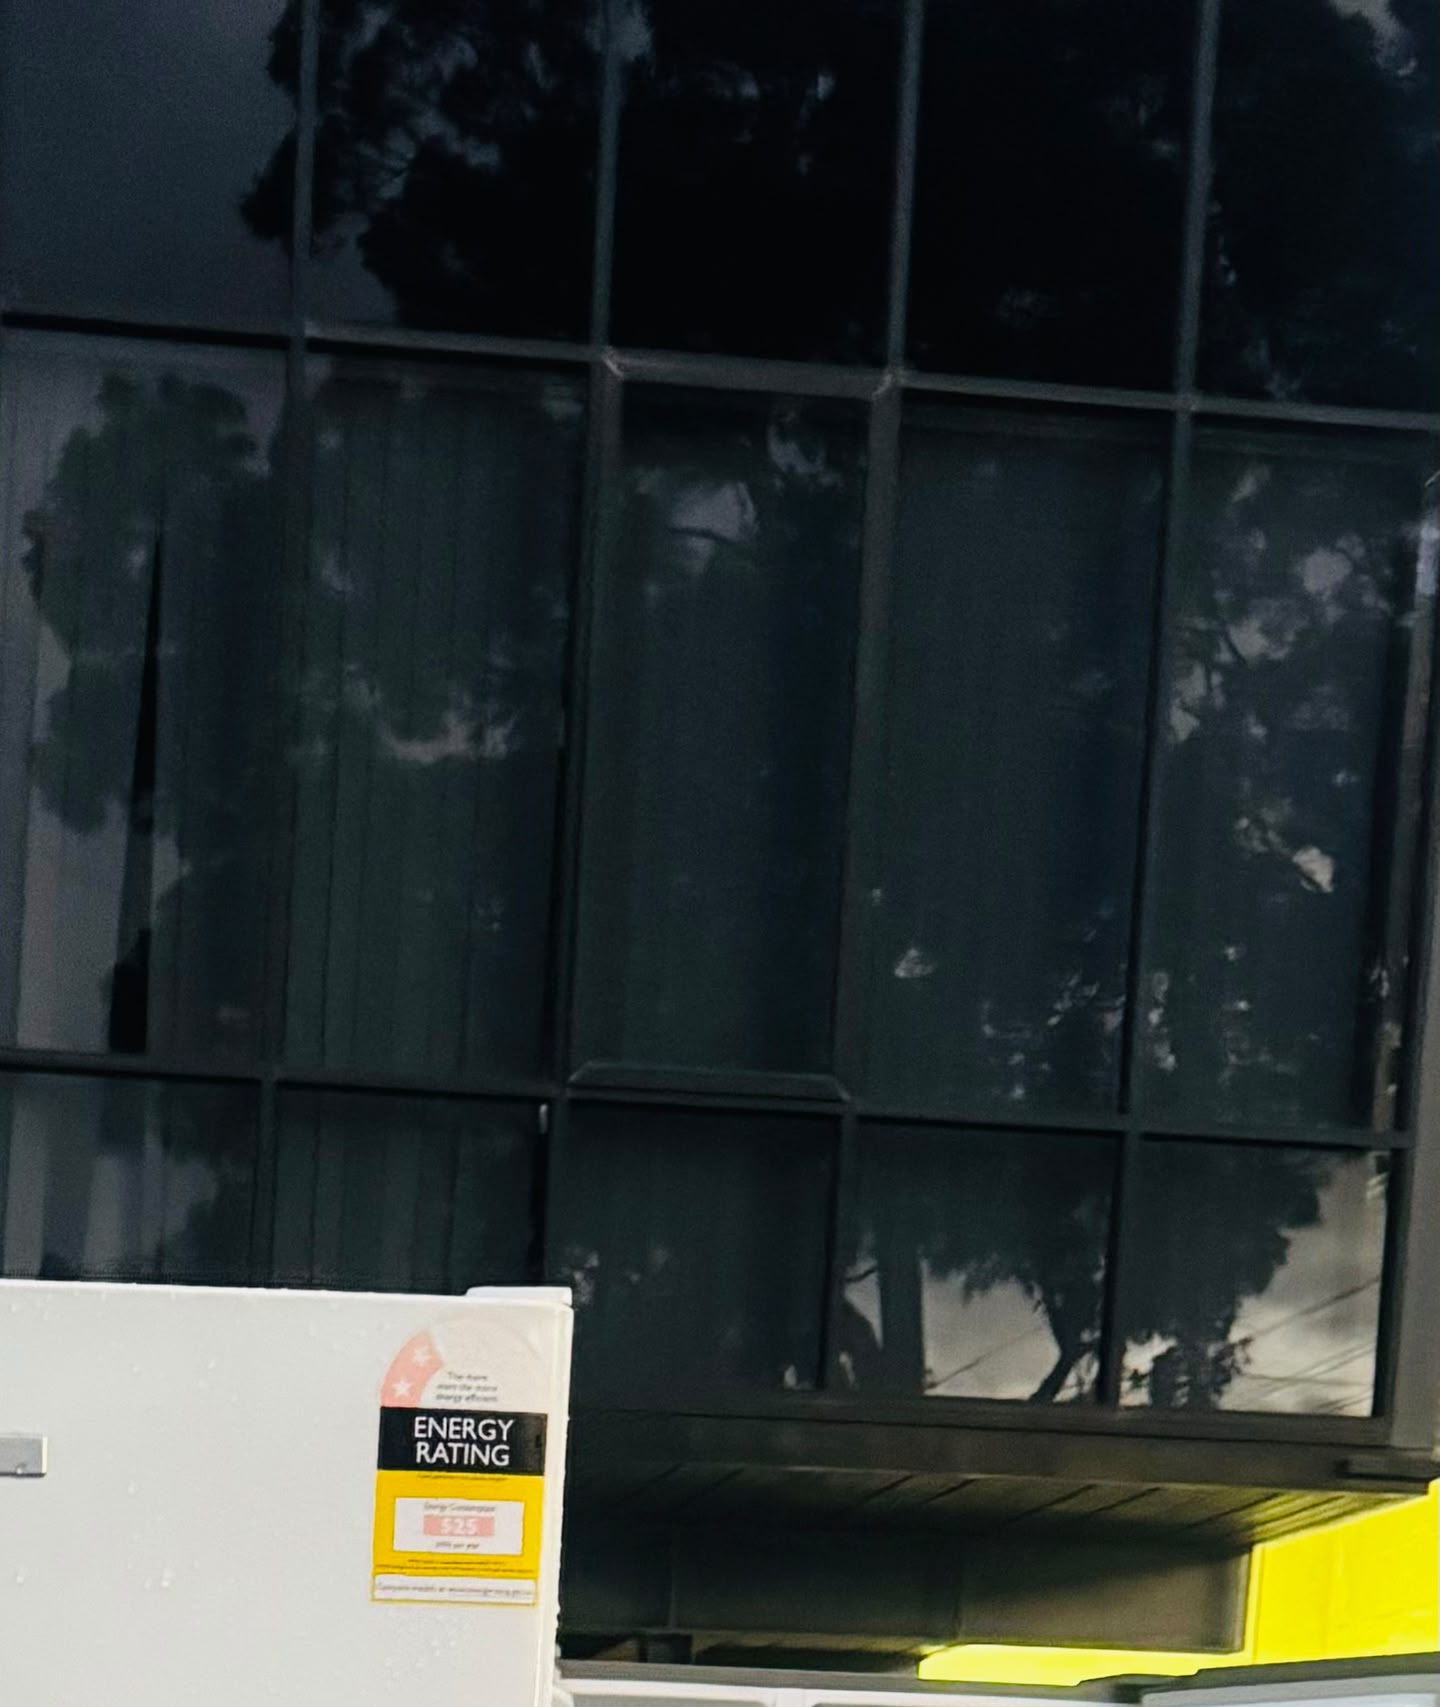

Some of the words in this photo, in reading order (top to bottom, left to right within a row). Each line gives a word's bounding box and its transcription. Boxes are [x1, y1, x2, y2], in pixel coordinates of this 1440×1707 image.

[414, 1416, 514, 1441] ENERGY
[415, 1442, 510, 1466] RATING
[440, 1518, 479, 1535] 525
